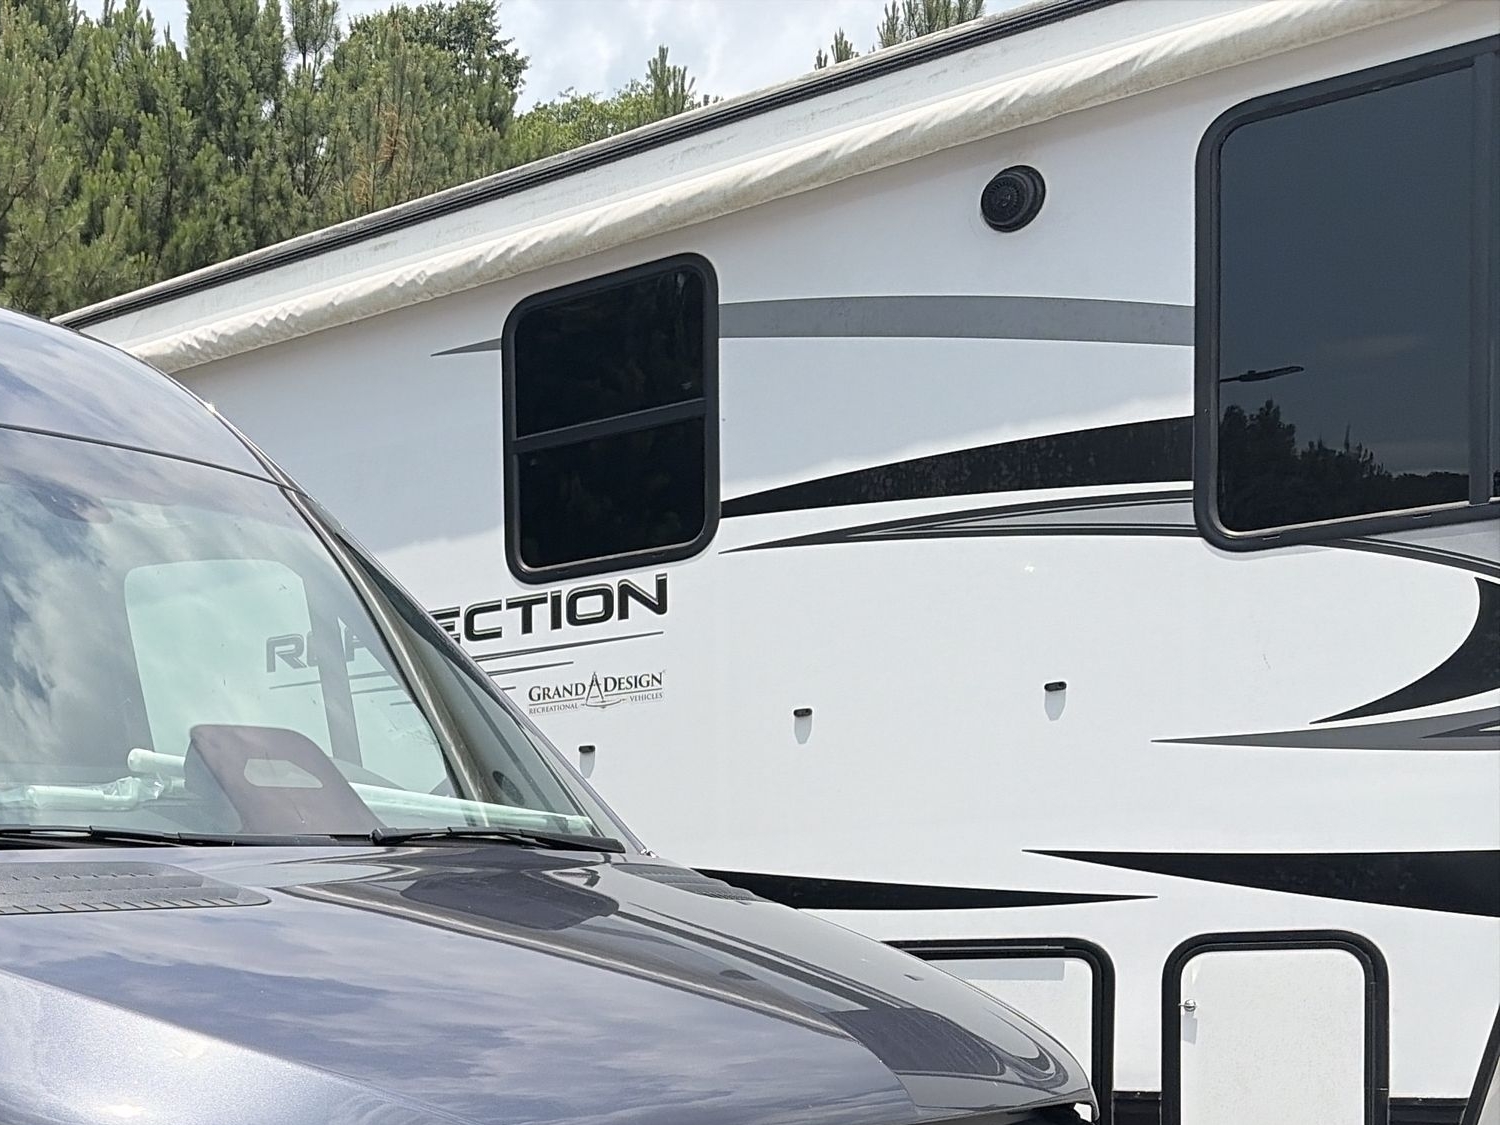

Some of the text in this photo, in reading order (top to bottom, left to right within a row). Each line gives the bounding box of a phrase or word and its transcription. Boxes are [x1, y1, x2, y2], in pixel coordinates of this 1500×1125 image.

[528, 671, 663, 702] GRAND DESIGN
[528, 692, 663, 715] RECREATIONAL VEHICLES
